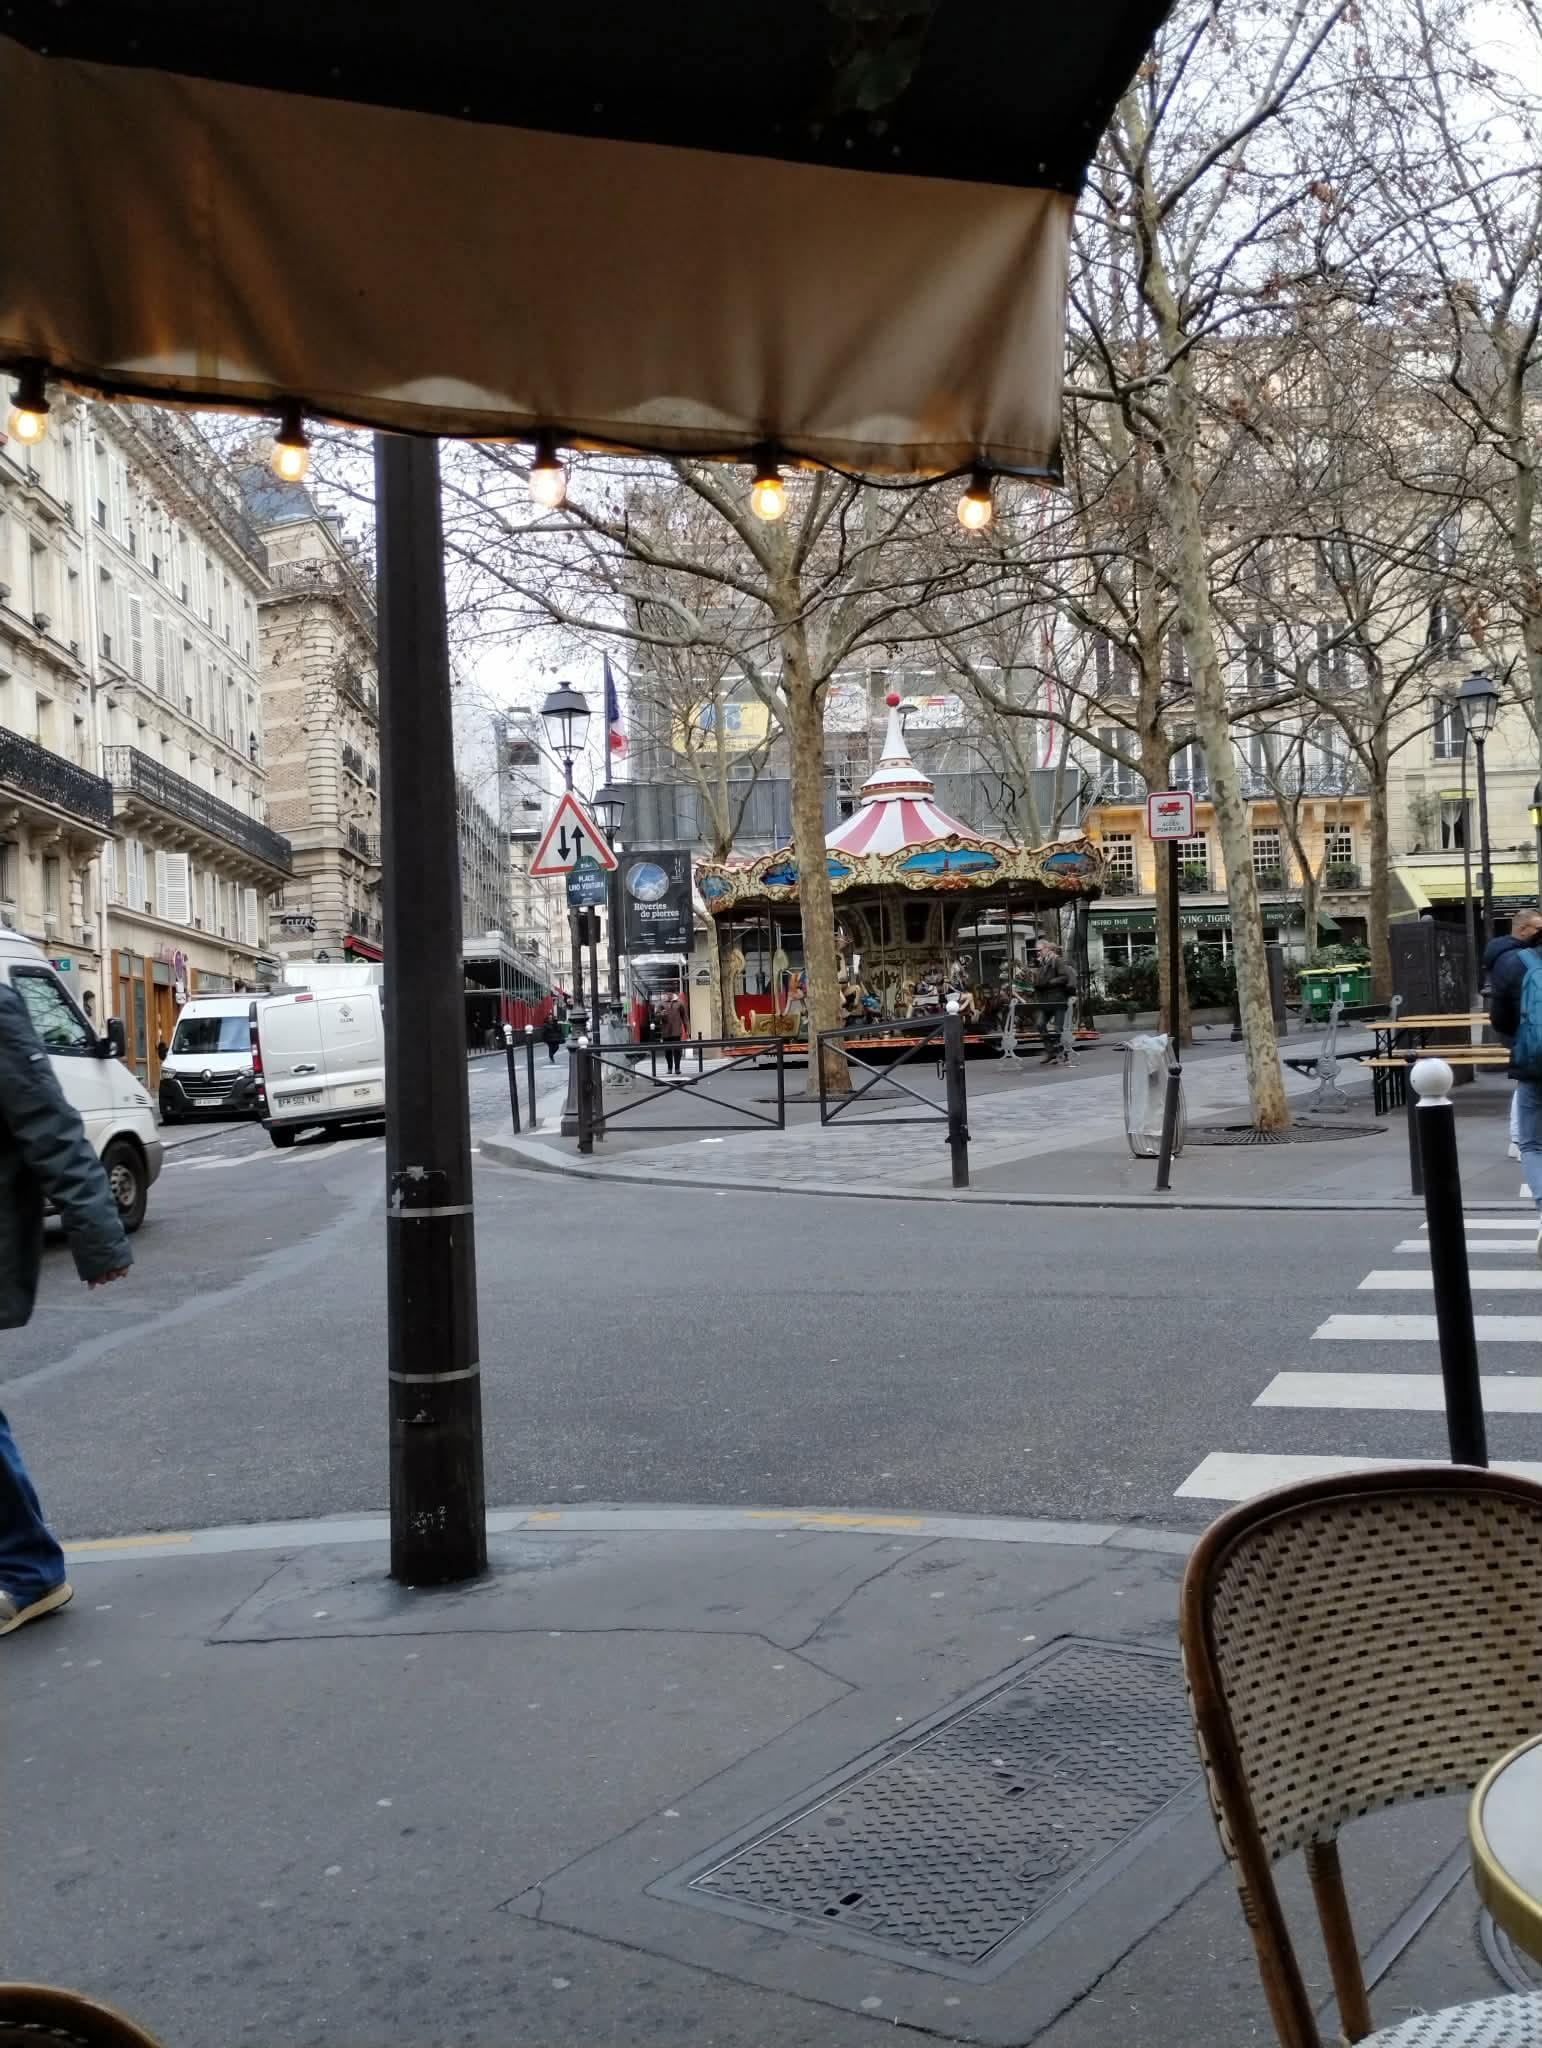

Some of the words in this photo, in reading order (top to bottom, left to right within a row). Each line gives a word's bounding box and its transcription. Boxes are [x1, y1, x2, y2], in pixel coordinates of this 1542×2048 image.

[578, 874, 595, 882] PLACE
[568, 883, 581, 891] LINO
[581, 881, 604, 889] VENTURA
[640, 910, 650, 918] de
[652, 909, 680, 919] pierres
